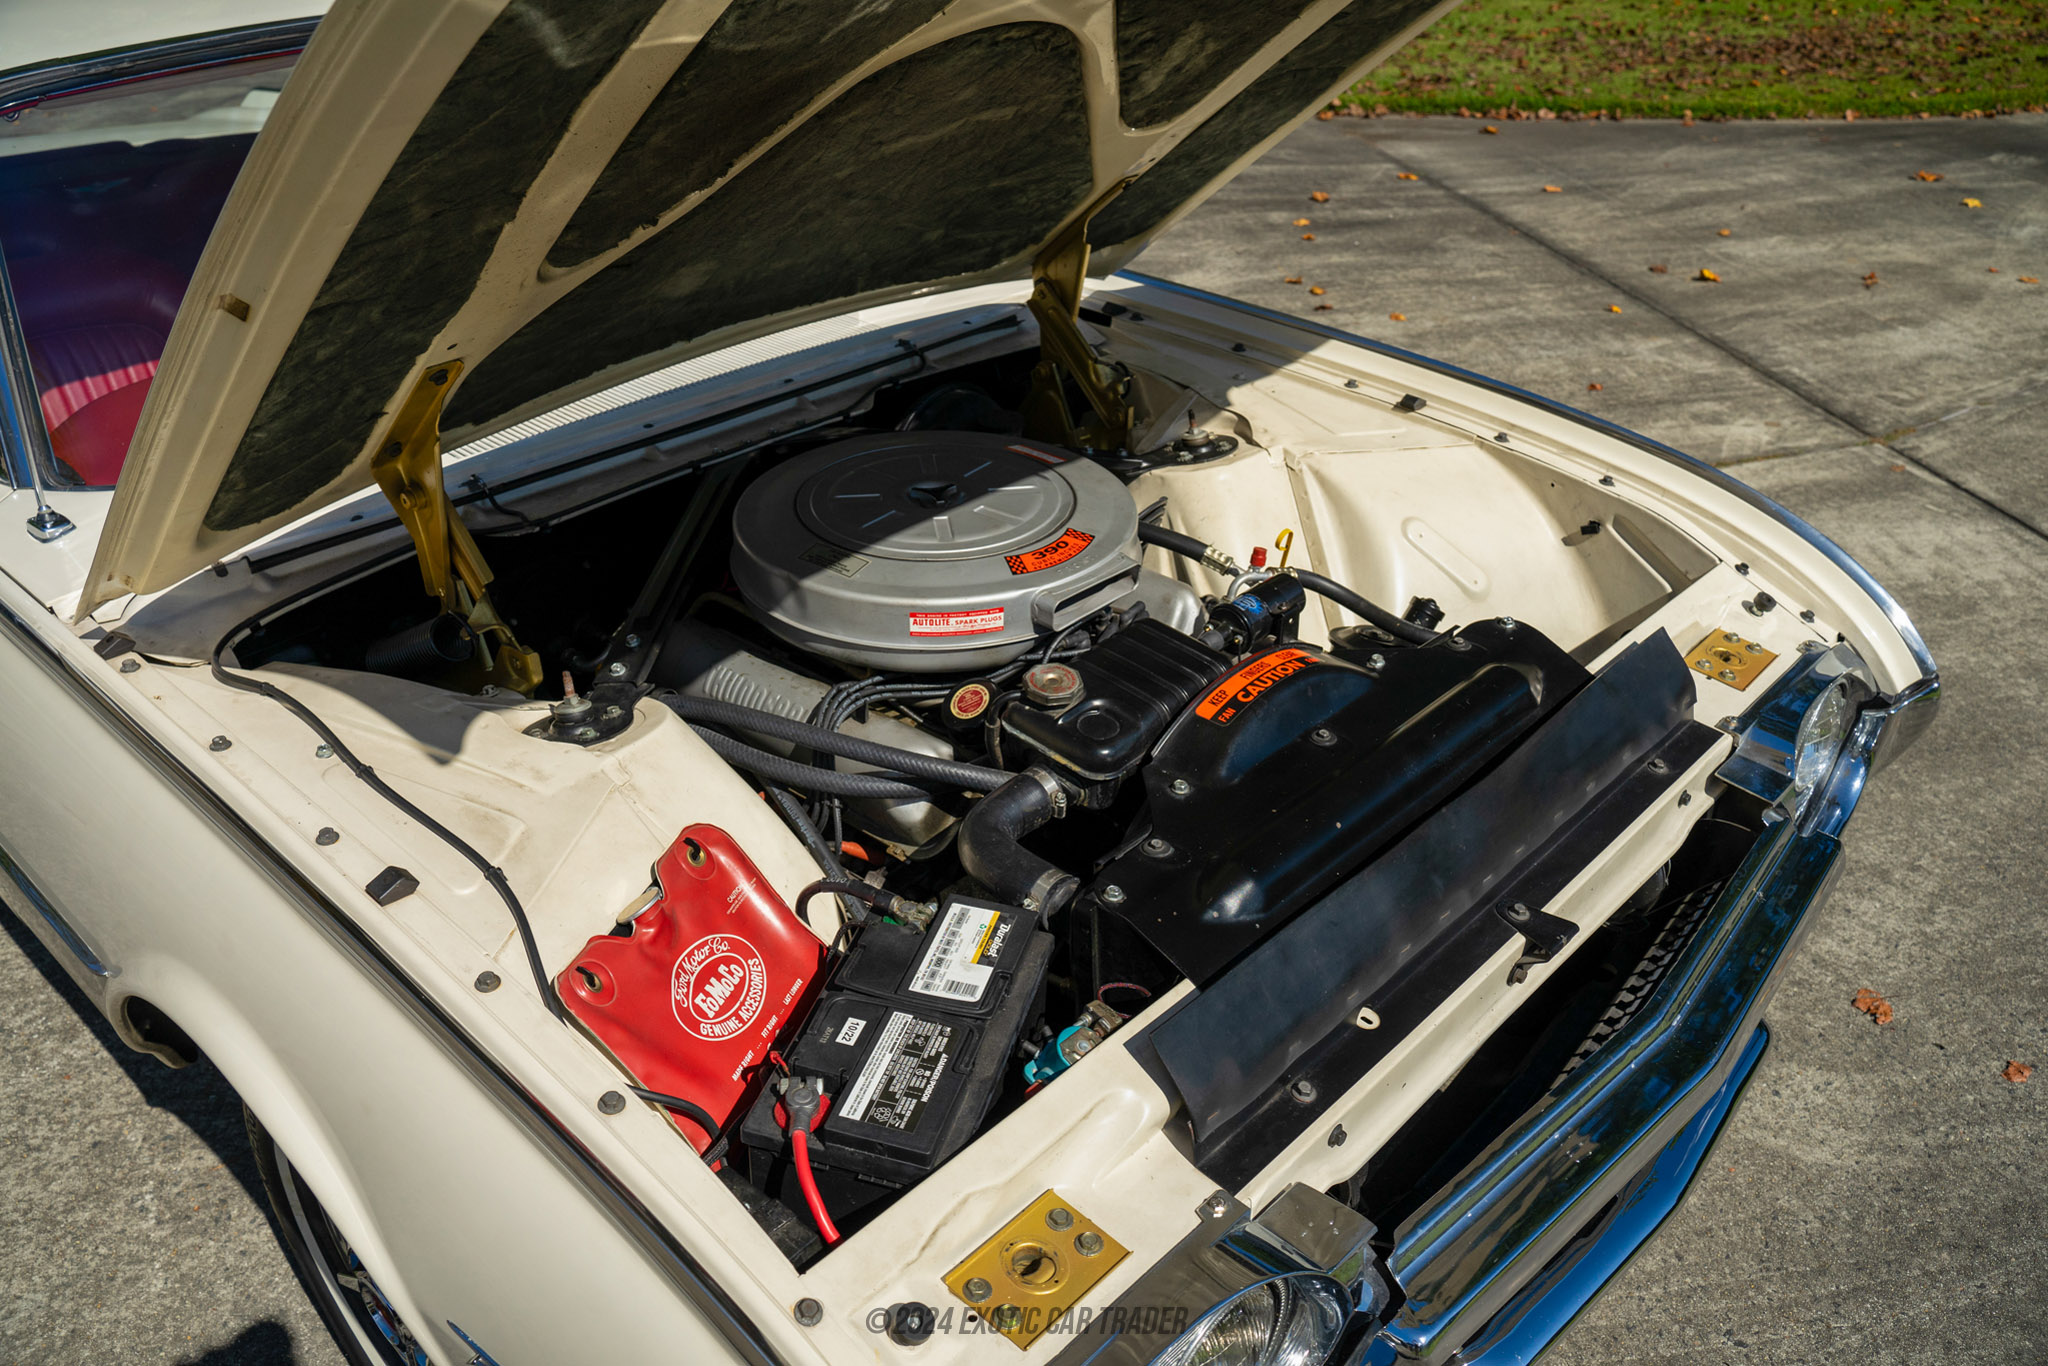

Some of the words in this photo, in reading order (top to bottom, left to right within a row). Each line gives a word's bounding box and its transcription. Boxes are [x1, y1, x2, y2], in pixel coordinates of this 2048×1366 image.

[1031, 540, 1069, 560] 390
[912, 618, 950, 626] AUTOLITE
[980, 615, 1002, 623] PLUGS
[1208, 689, 1229, 707] KEEP
[1240, 661, 1272, 681] FINGERS
[1218, 707, 1237, 723] FAN
[1236, 660, 1306, 703] CAUTION
[708, 937, 731, 954] Co.
[987, 922, 1011, 958] Duralast
[681, 945, 711, 982] Motor
[674, 968, 690, 1008] Ford
[694, 963, 745, 1019] FoMoCo
[700, 1016, 743, 1037] GENUINE
[738, 957, 763, 1022] ACCESSORIES
[760, 1026, 770, 1039] FIT
[782, 991, 793, 1005] LAST
[840, 1021, 860, 1042] 10/22
